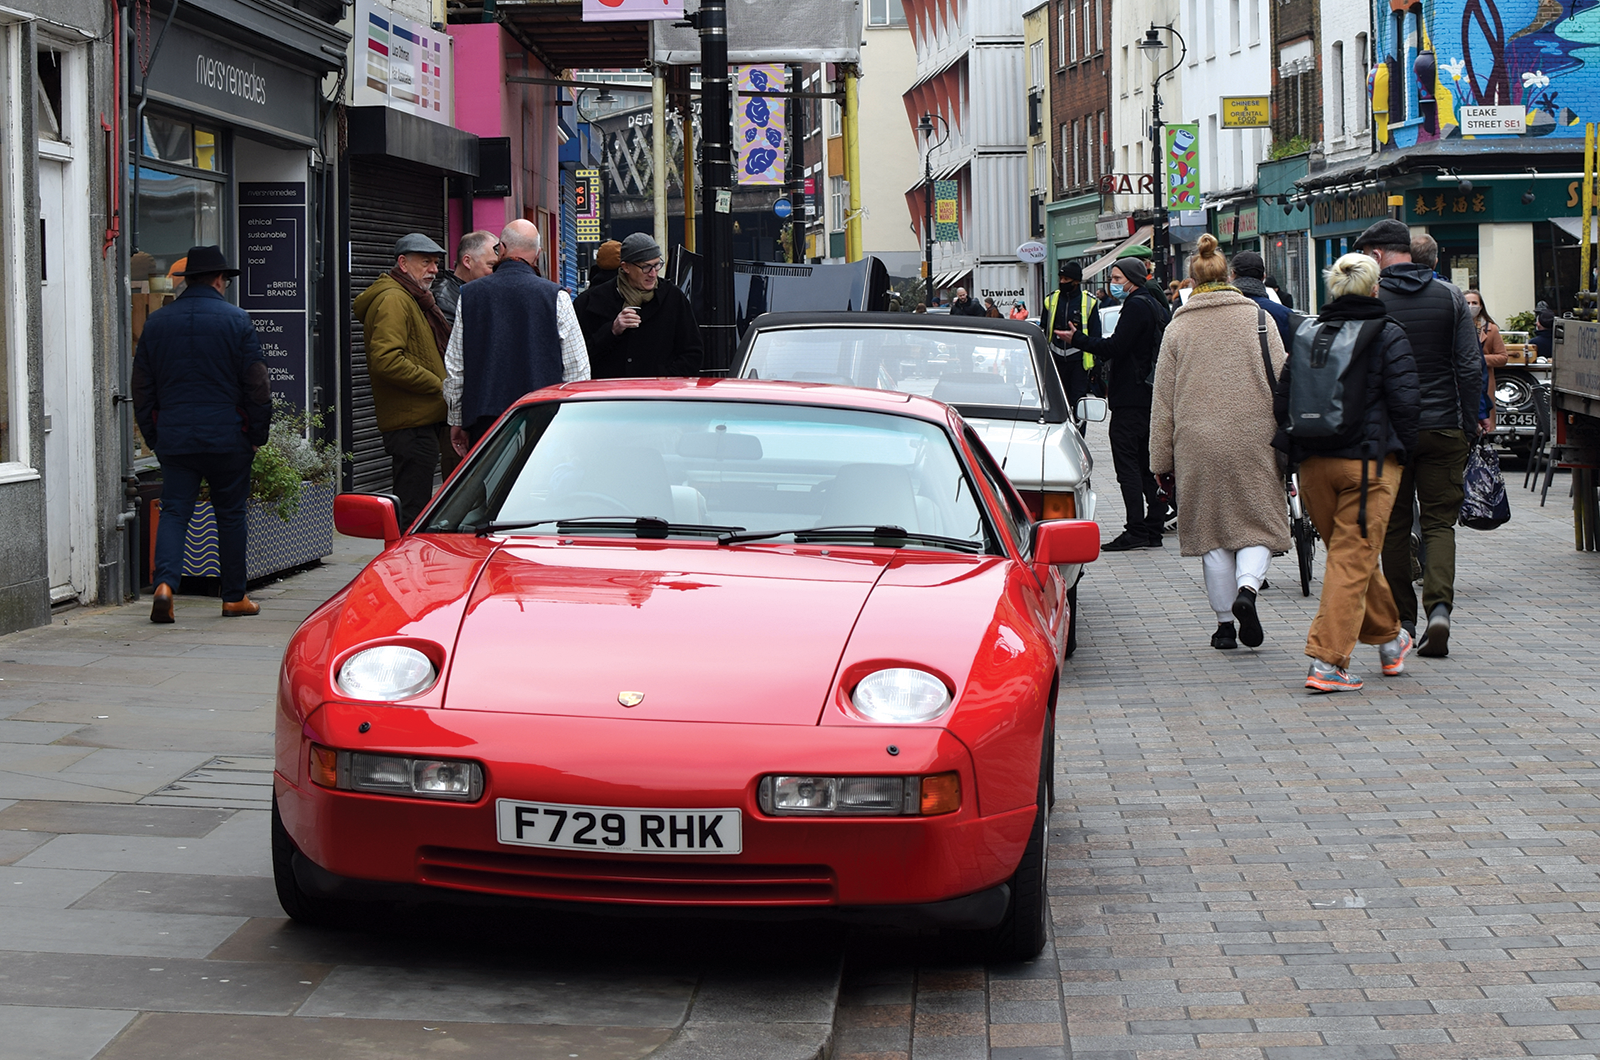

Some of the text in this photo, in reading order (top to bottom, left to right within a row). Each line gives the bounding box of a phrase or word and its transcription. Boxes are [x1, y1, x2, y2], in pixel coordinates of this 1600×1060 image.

[1467, 109, 1497, 117] LEAKE
[1467, 120, 1520, 129] STREET SE1
[1100, 174, 1154, 194] BAR
[981, 288, 1025, 297] Unwined
[515, 806, 724, 848] F729 RHK
